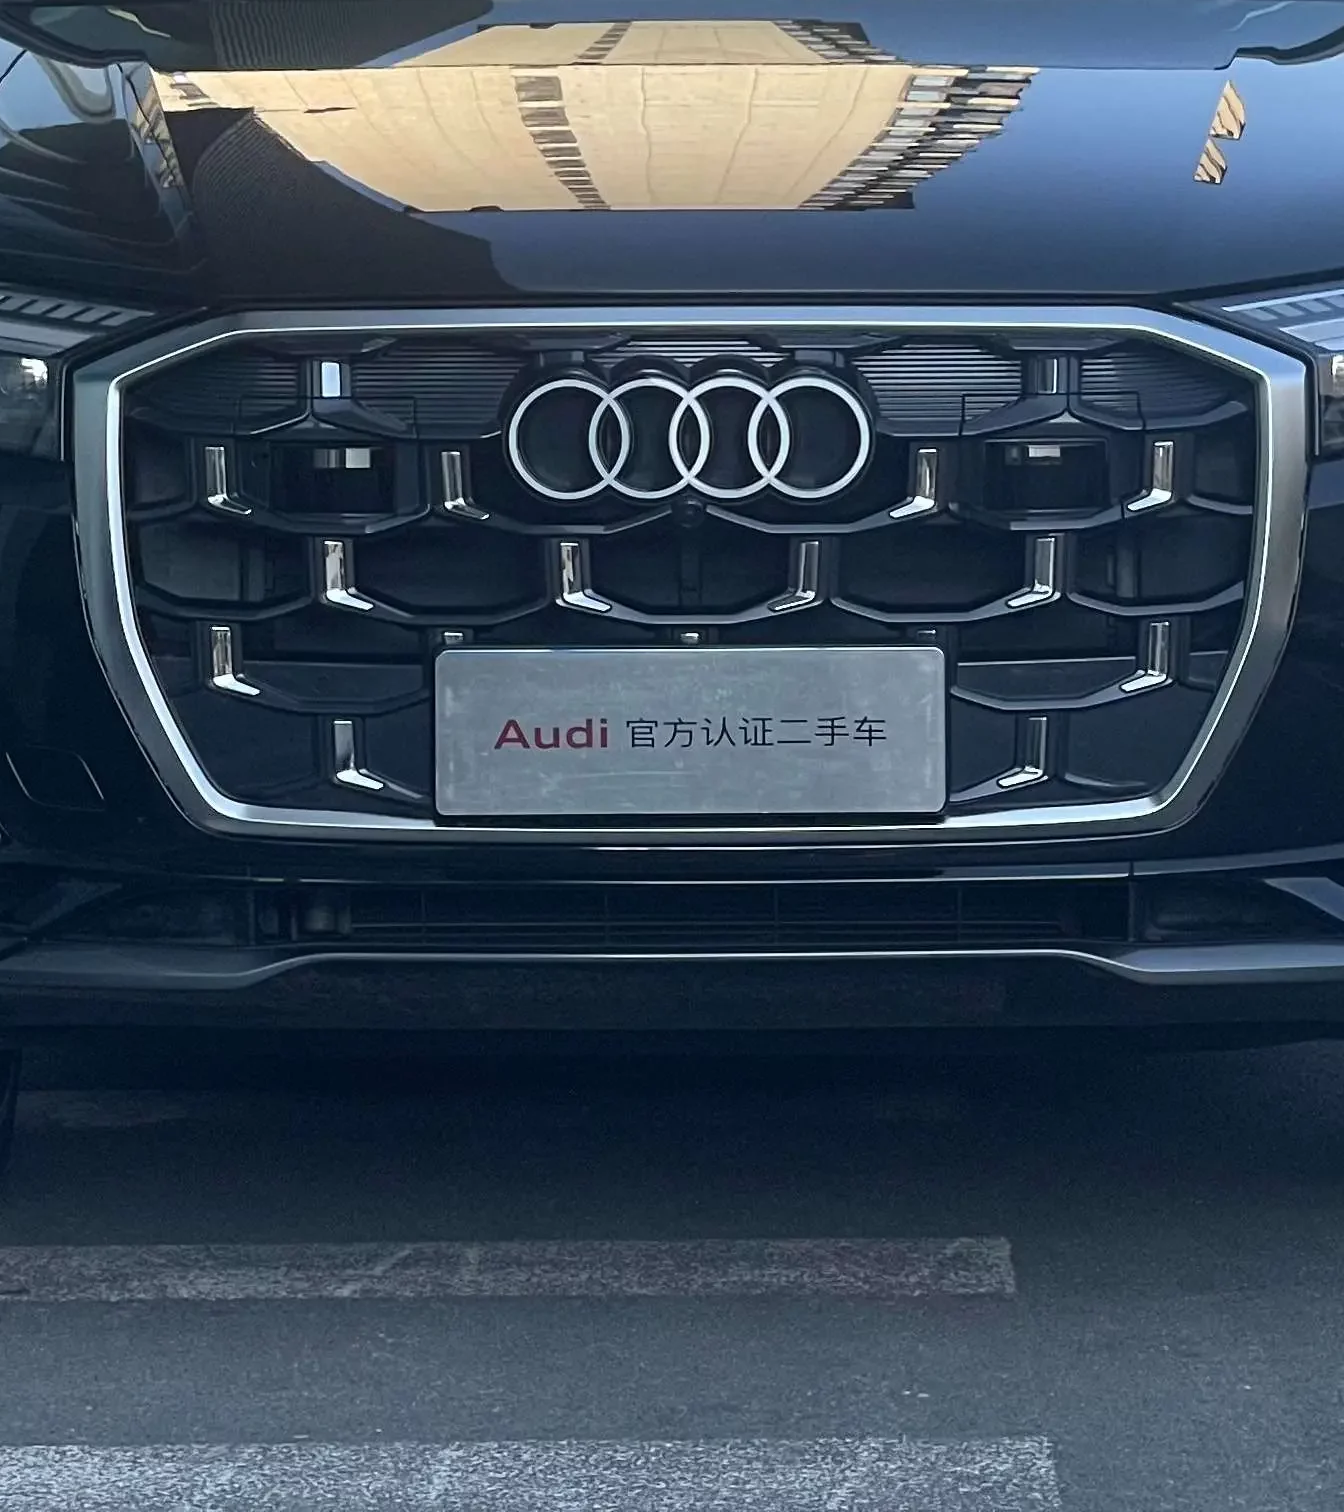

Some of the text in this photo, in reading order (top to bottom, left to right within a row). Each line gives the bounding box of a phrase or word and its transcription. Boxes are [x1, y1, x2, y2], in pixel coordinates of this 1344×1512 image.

[494, 715, 887, 749] Audi 官方认证二手车
